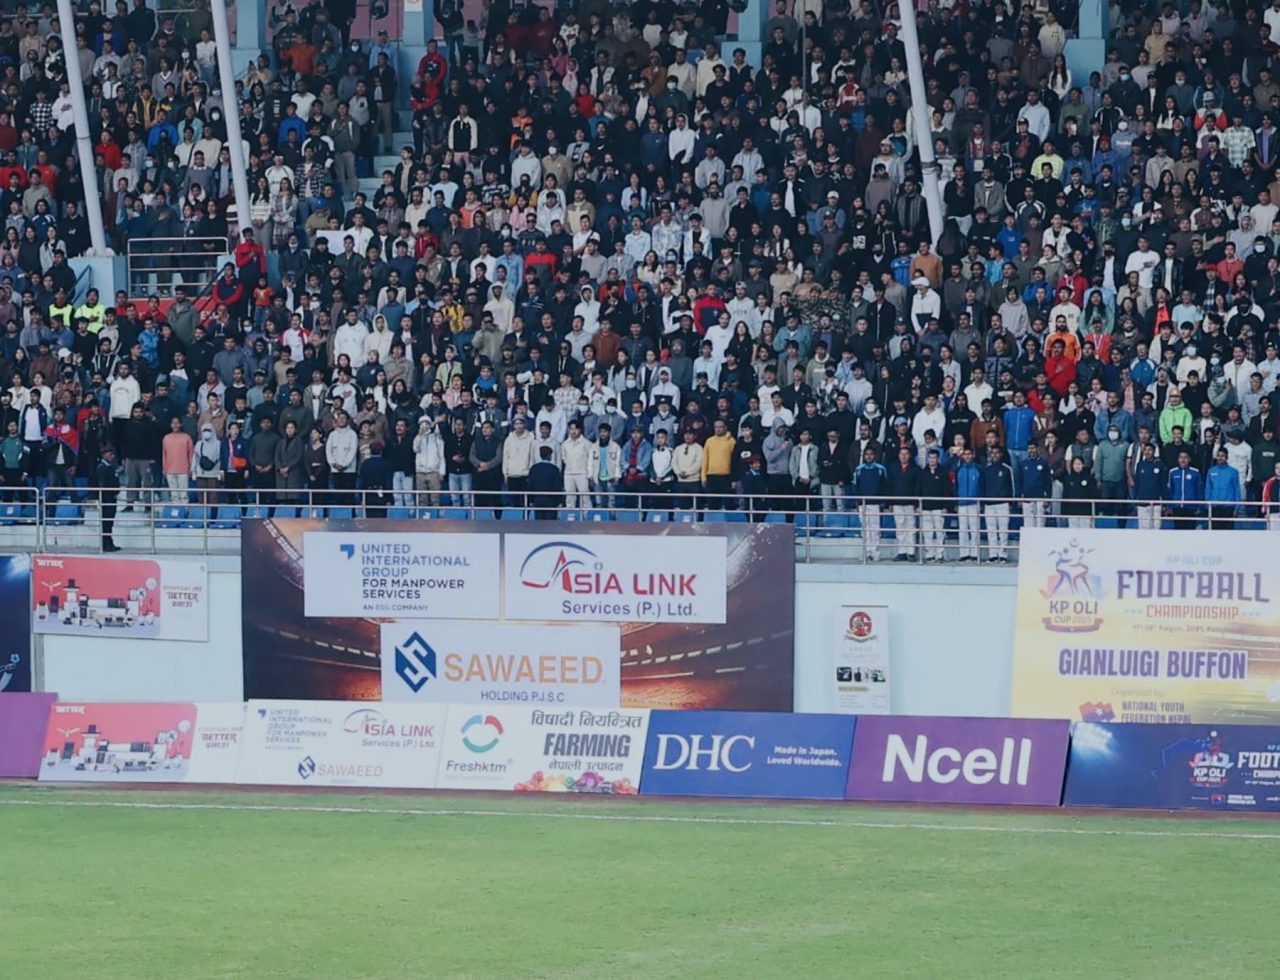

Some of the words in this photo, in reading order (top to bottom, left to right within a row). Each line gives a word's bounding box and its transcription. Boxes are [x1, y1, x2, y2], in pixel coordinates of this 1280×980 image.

[361, 543, 411, 554] UNITED
[361, 556, 470, 567] INTERNATIONAL
[362, 567, 409, 578] GROUP
[362, 579, 387, 588] FOR
[391, 579, 465, 589] MANPOWER
[633, 573, 697, 596] LINK
[1117, 570, 1270, 603] FOOTBALL
[362, 590, 421, 599] SERVICES
[562, 600, 630, 615] Services
[636, 602, 661, 618] (P.)
[667, 602, 697, 617] Ltd.
[1050, 601, 1069, 614] KP
[1073, 601, 1098, 614] OLI
[1146, 604, 1240, 620] CHAMPIONSHIP
[444, 653, 603, 684] SAWAEED
[1058, 648, 1160, 677] GIANLUIGI
[1166, 651, 1247, 680] BUFFON
[481, 690, 528, 701] HOLDING
[1122, 701, 1157, 712] NATIONAL
[1161, 702, 1185, 712] YOUTH
[401, 725, 435, 737] LINK
[200, 733, 238, 745] BETTER
[362, 739, 400, 748] Services
[543, 733, 631, 757] FARMING
[653, 733, 755, 772] DHC
[774, 746, 797, 754] Made
[799, 746, 807, 754] in
[809, 747, 837, 757] Japan.
[767, 756, 792, 765] Loved
[794, 757, 842, 767] Worldwide.
[882, 734, 1032, 786] Ncell
[317, 764, 384, 777] SAWAEED
[446, 760, 507, 773] Freshktm
[1193, 768, 1208, 776] KP
[1209, 768, 1226, 777] OLI
